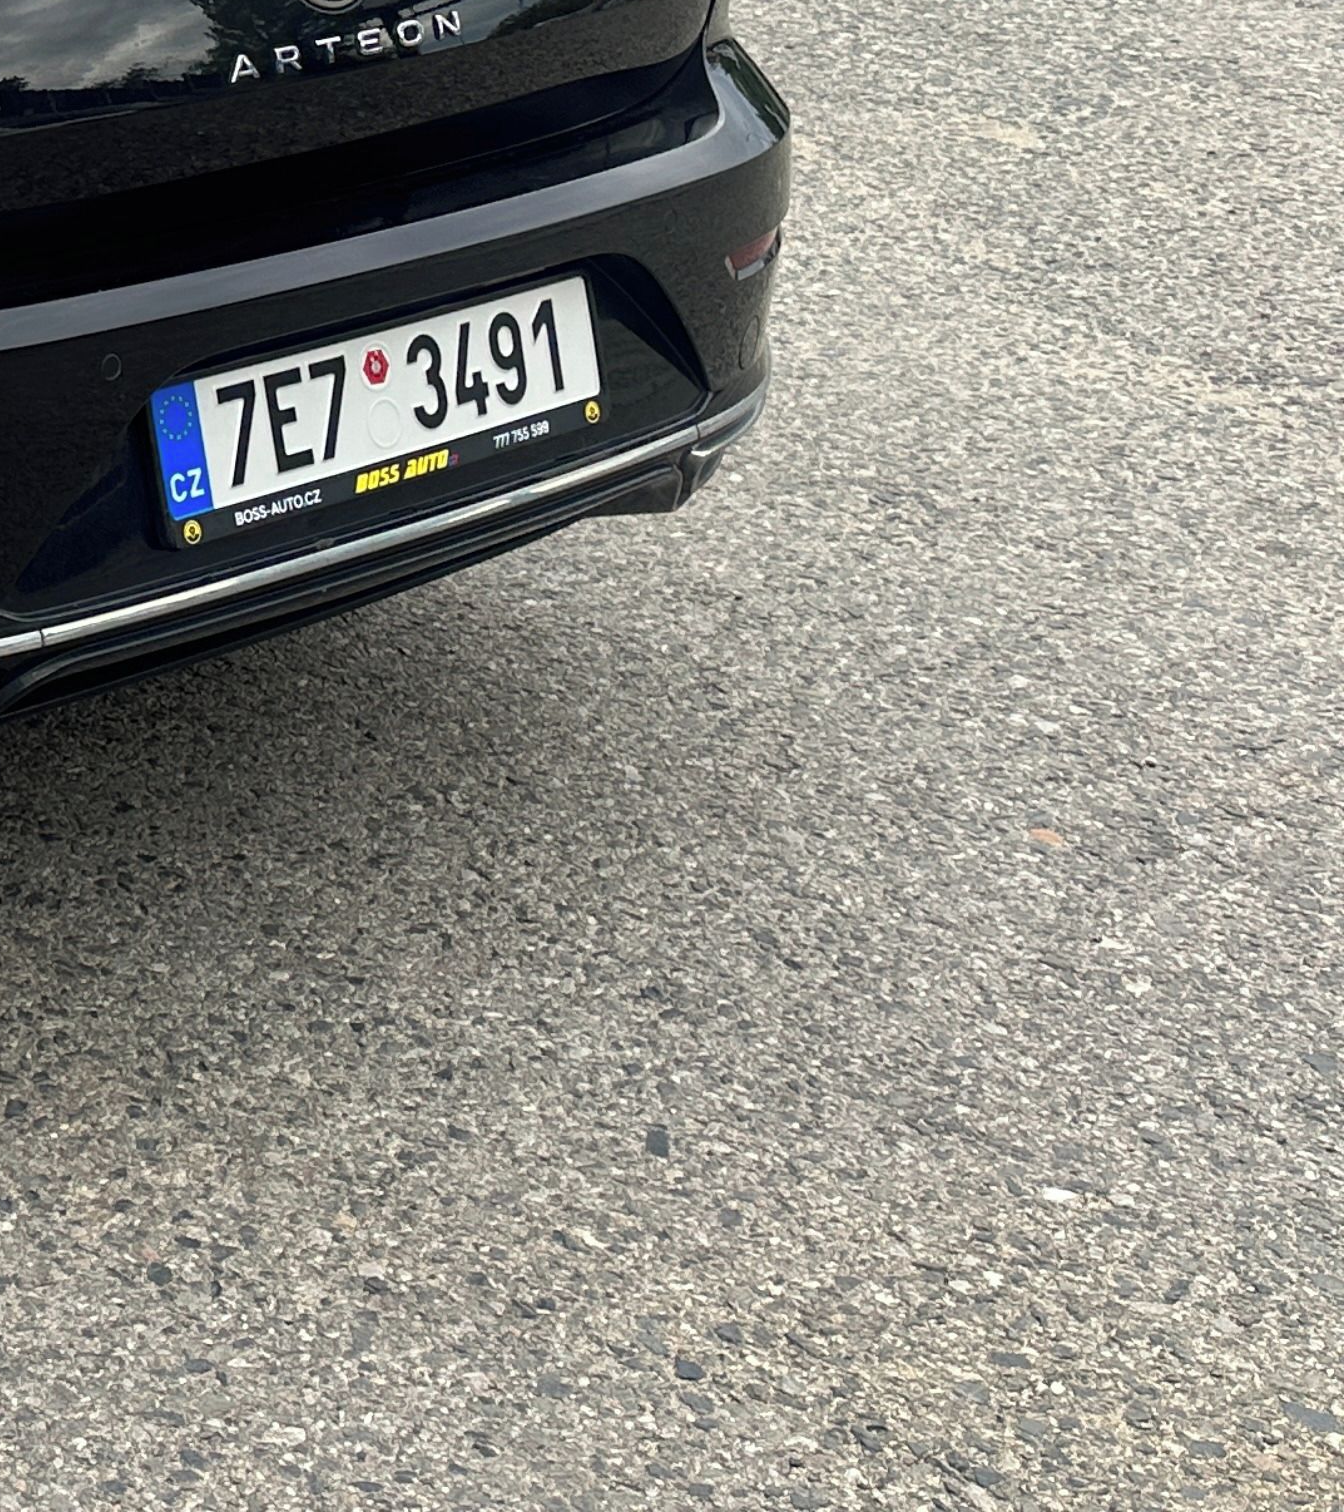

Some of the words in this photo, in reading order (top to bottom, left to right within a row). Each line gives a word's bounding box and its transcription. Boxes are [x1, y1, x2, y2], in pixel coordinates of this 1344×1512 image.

[230, 10, 462, 83] ARTEON
[216, 355, 346, 487] 7E7
[405, 299, 565, 429] 3491
[493, 432, 510, 449] 777
[170, 468, 205, 503] CZ
[355, 463, 400, 494] BOSS
[403, 448, 449, 480] AUTO
[234, 489, 323, 526] BOSS-AUTO.CZ
